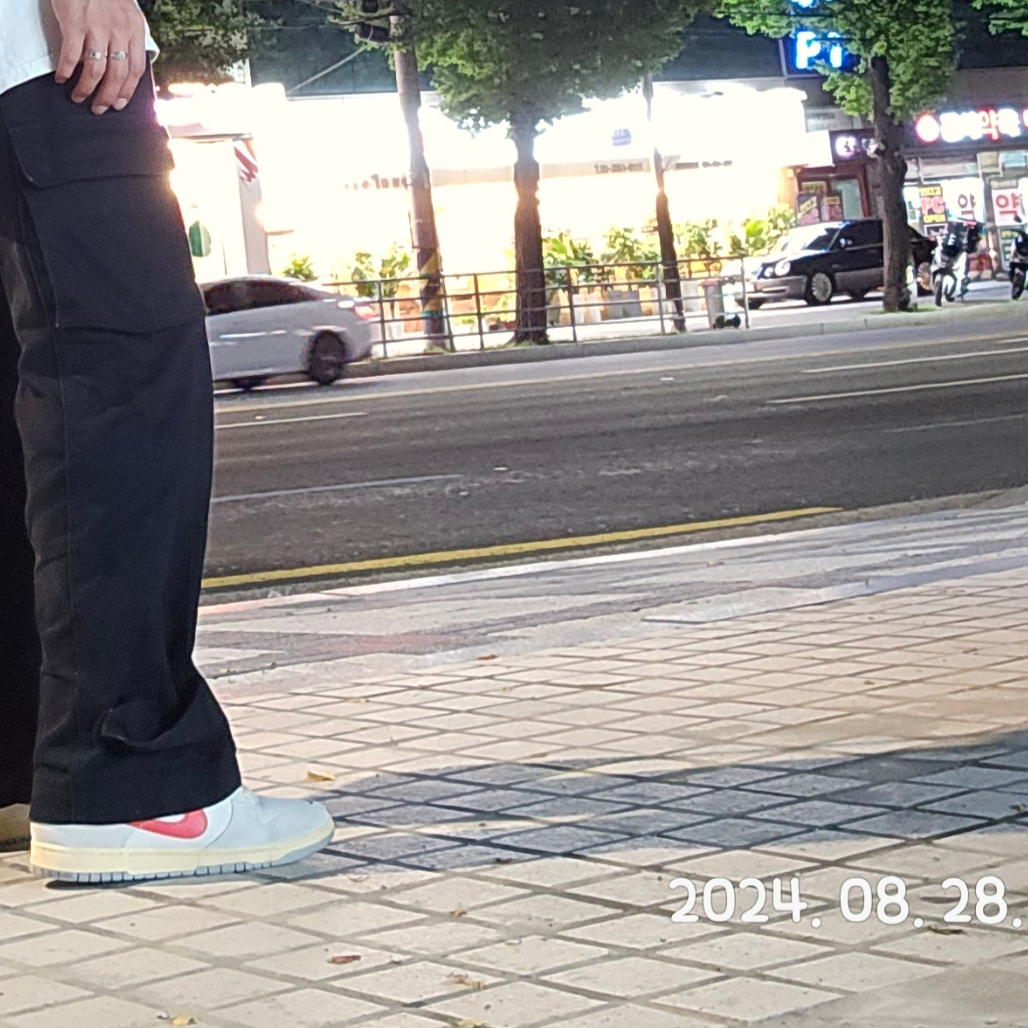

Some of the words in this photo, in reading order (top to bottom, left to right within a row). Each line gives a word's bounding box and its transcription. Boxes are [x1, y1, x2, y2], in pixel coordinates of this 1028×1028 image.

[921, 196, 945, 215] PC
[957, 193, 977, 223] 약
[995, 192, 1020, 220] 약
